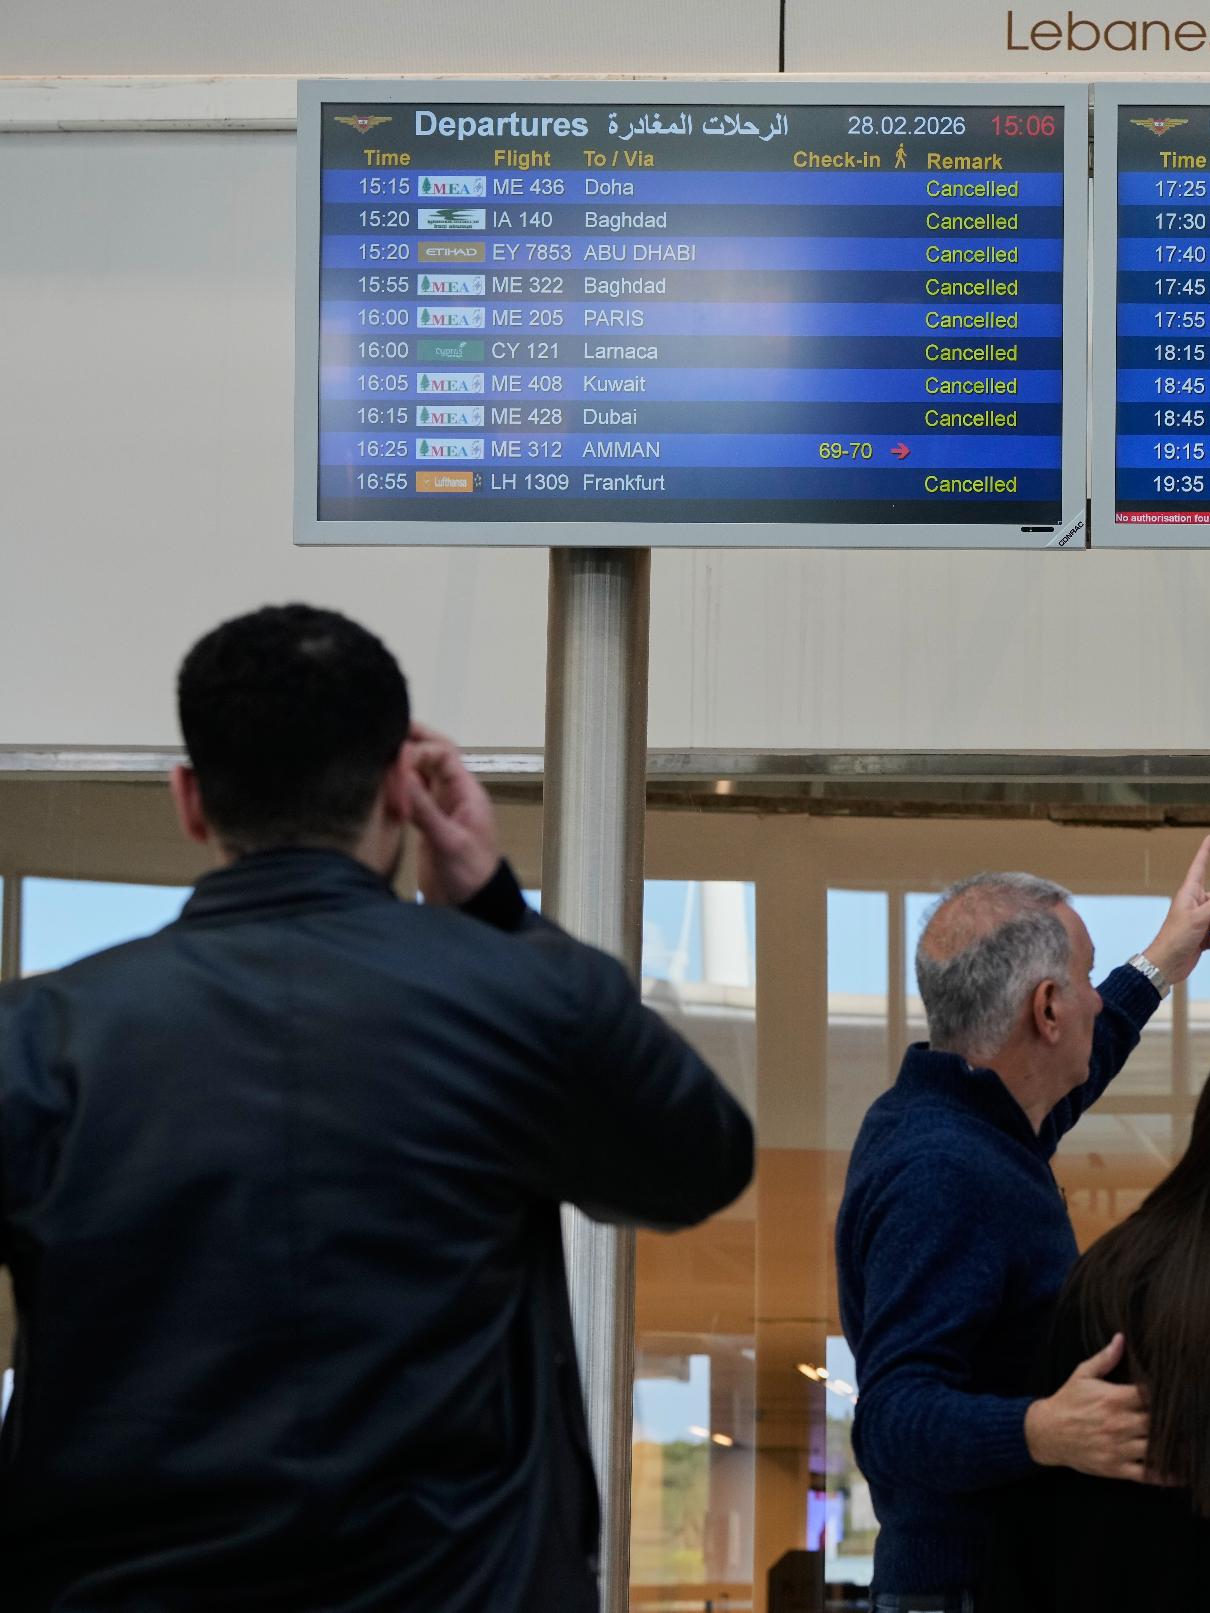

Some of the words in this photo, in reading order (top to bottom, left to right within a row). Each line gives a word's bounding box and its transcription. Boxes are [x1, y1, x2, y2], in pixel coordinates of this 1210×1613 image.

[415, 110, 589, 141] Departures
[608, 111, 693, 141] المغادرة
[702, 112, 789, 142] الرحلات
[847, 115, 966, 135] 28.02.2026
[991, 114, 1055, 136] 15:06
[363, 149, 411, 166] Time
[494, 149, 551, 170] Flight
[584, 151, 606, 167] To
[611, 150, 618, 167] /
[624, 151, 655, 167] Via
[793, 150, 881, 168] Check-in
[927, 152, 1003, 169] Remark
[1160, 152, 1207, 169] Time
[360, 178, 409, 195] 15:15
[494, 179, 523, 195] ME
[530, 179, 565, 195] 436
[586, 179, 634, 195] Doha
[927, 180, 1018, 197] Cancelled
[1155, 181, 1206, 197] 17:25
[359, 211, 409, 227] 15:20
[494, 211, 512, 228] IA
[520, 212, 552, 228] 140
[586, 212, 667, 233] Baghdad
[926, 213, 1018, 230] Cancelled
[1155, 213, 1206, 230] 17:30
[359, 244, 409, 260] 15:20
[426, 247, 477, 256] ETIHAD
[493, 244, 520, 260] EY
[526, 244, 572, 260] 7853
[584, 245, 625, 261] ABU
[634, 245, 696, 261] DHABI
[926, 246, 1018, 263] Cancelled
[1155, 312, 1205, 328] 17:55
[359, 342, 409, 358] 16:00
[492, 342, 520, 359] CY
[528, 343, 558, 359] 121
[584, 343, 658, 360] Larnaca
[926, 344, 1017, 361] Cancelled
[1154, 377, 1205, 394] 18:45
[1154, 410, 1205, 427] 18:45
[358, 441, 408, 457] 16:25
[492, 441, 521, 458] ME
[528, 441, 562, 458] 312
[582, 442, 660, 458] AMMAN
[819, 443, 872, 459] 69-70
[357, 473, 407, 490] 16:55
[492, 474, 517, 490] LH
[525, 474, 569, 491] 1309
[584, 474, 665, 491] Frankfurt
[925, 476, 1016, 493] Cancelled
[1153, 476, 1204, 493] 19:35
[1115, 513, 1129, 523] No
[1131, 513, 1192, 523] authorisation
[1058, 521, 1084, 547] CONRAC
